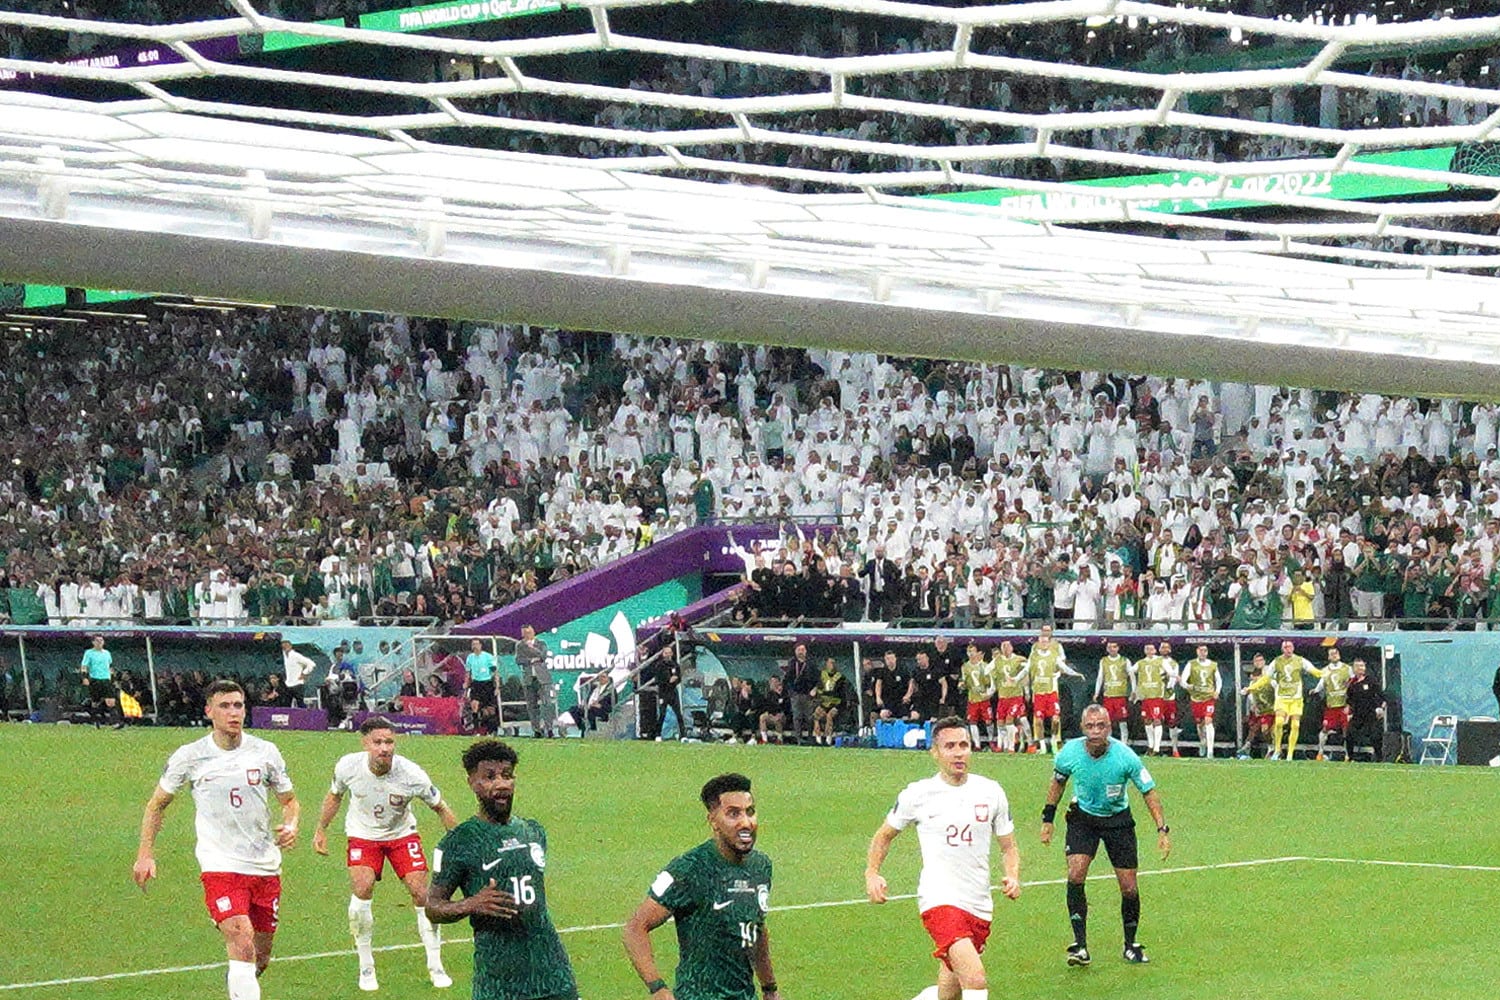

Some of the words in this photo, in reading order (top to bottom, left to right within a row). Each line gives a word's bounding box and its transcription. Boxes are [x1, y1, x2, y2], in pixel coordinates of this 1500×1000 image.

[421, 5, 459, 26] WORLD
[229, 787, 242, 808] 6
[374, 804, 385, 819] 2
[946, 823, 973, 847] 24
[407, 841, 422, 859] 2
[510, 875, 536, 905] 16
